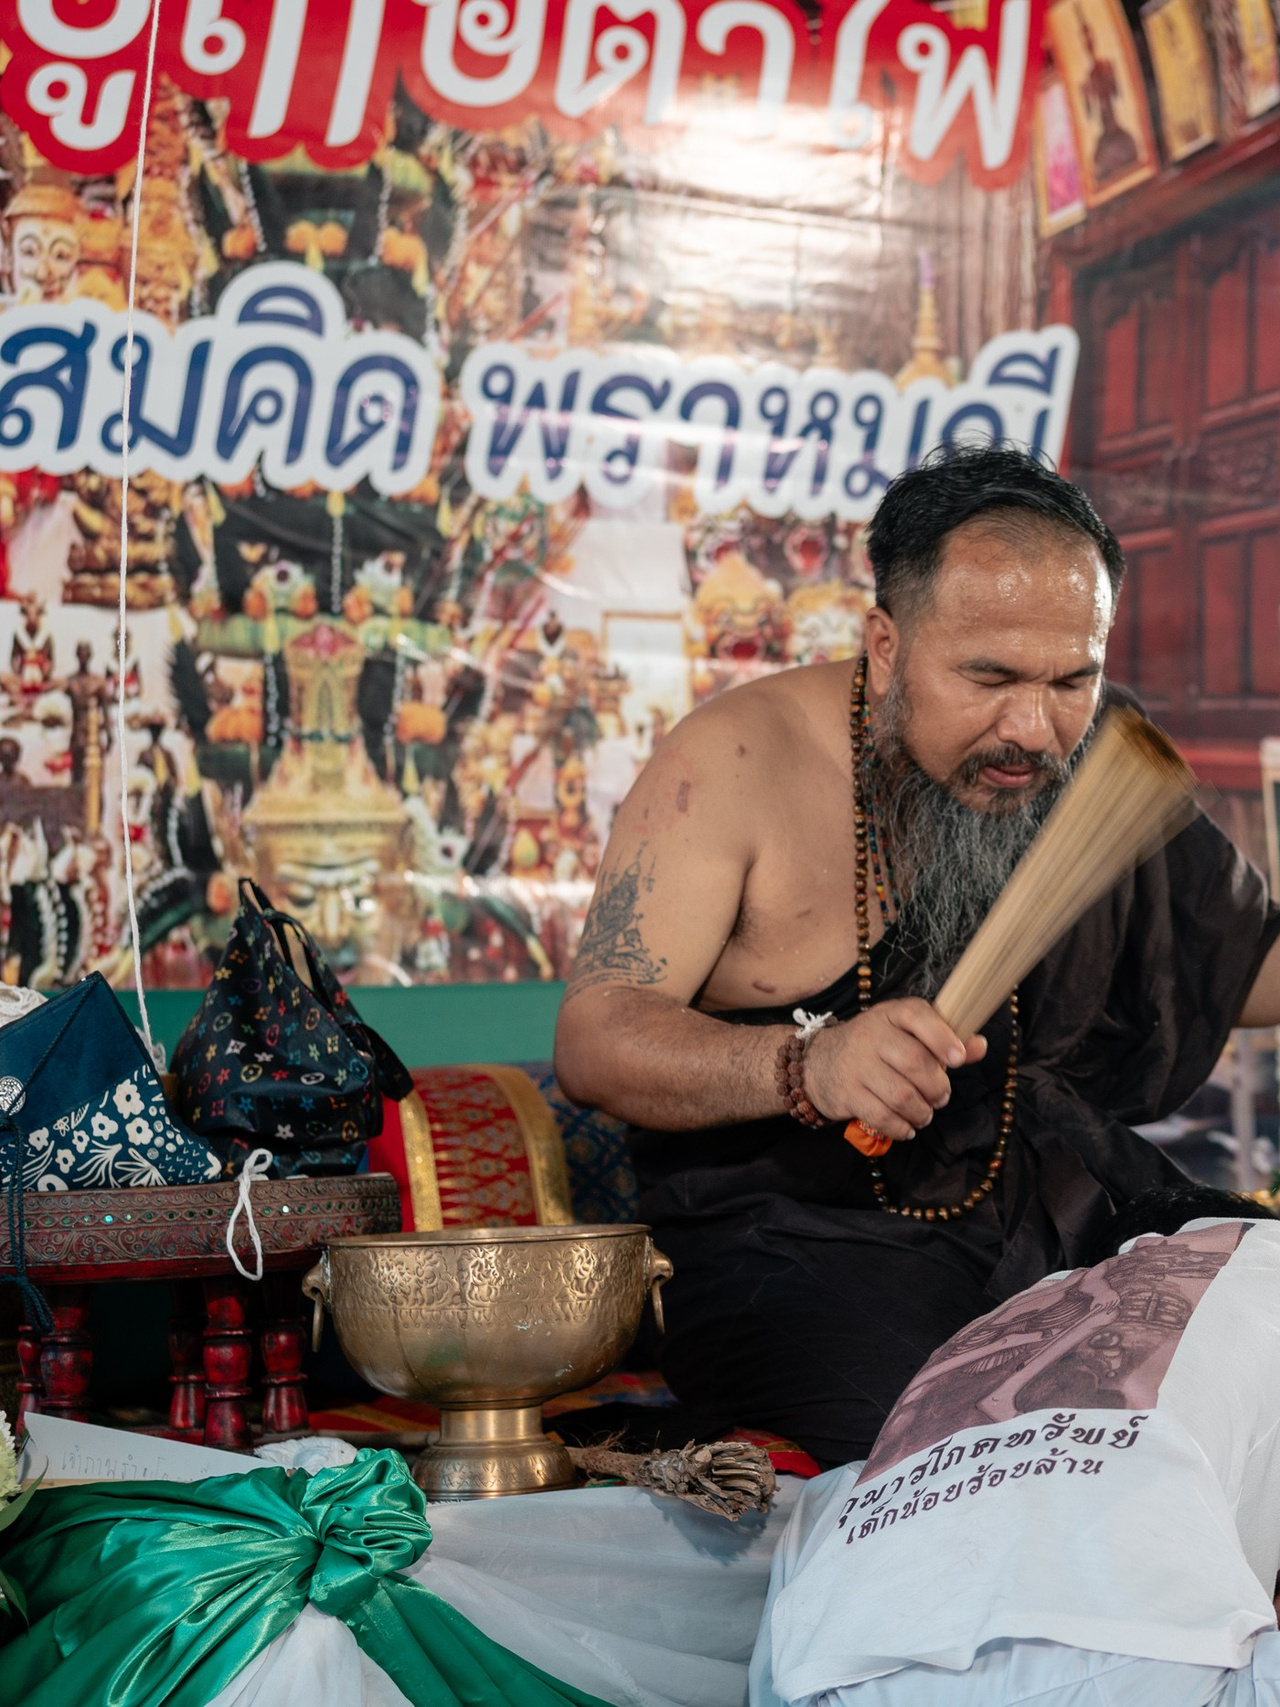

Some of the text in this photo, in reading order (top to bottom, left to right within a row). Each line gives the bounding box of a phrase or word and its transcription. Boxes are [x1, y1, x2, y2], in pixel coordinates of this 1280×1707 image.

[0, 285, 421, 474] สมคิด
[838, 1412, 1149, 1529] กุมารโภคทรัพย์
[846, 1447, 1104, 1545] เด็กน้อยร้อยล้าน
